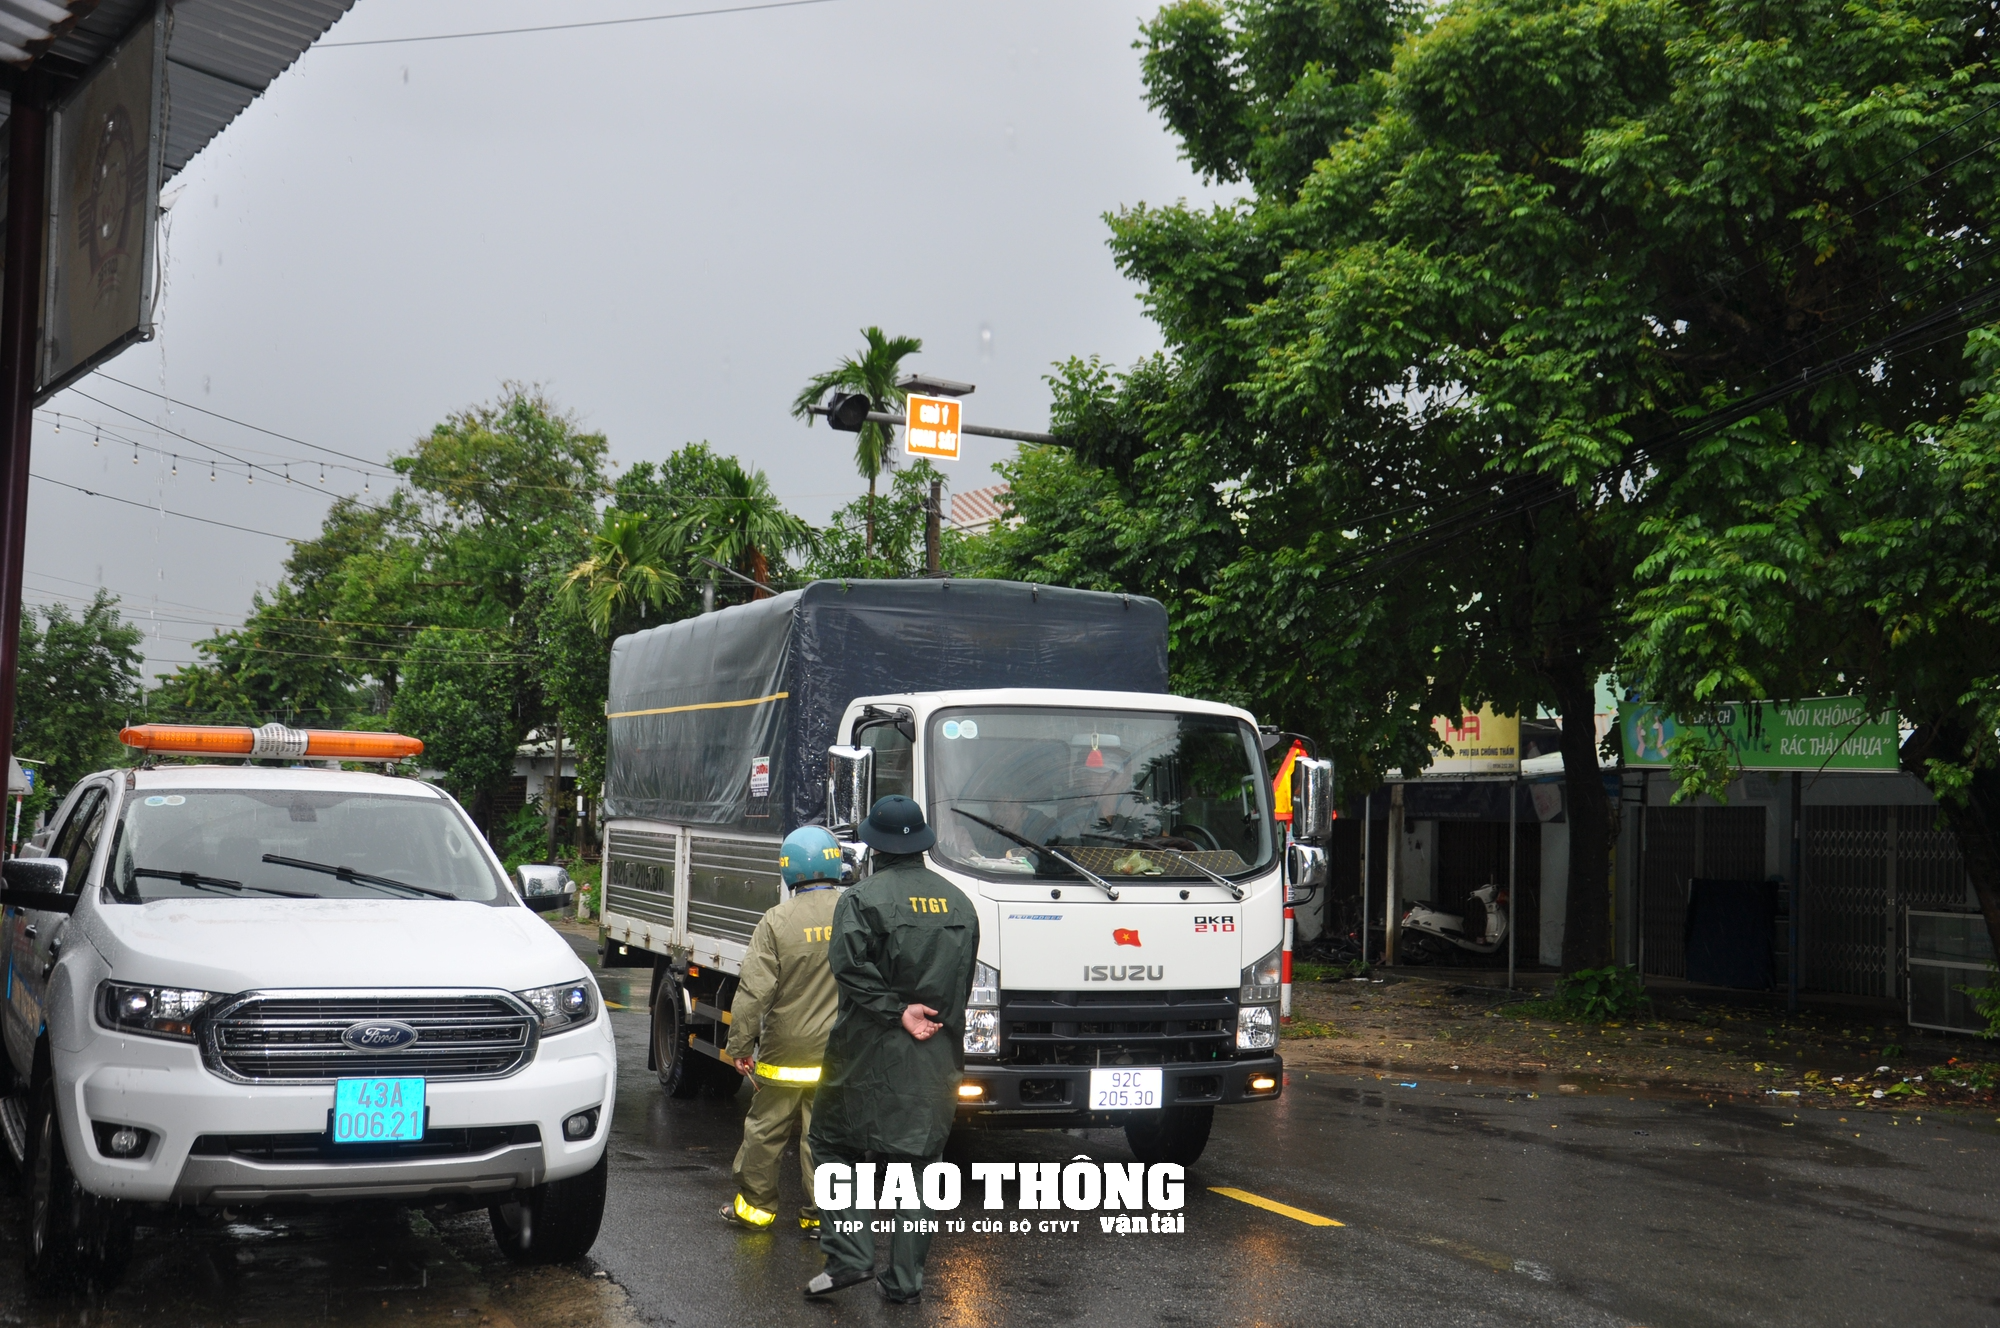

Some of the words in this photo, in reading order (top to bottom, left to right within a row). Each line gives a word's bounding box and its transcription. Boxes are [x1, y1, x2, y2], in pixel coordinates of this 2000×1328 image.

[937, 429, 957, 451] SÁT
[1812, 704, 1862, 727] KHÔNG
[1780, 733, 1807, 755] RÁC
[1809, 732, 1839, 756] THẢI
[909, 896, 949, 913] TTGT
[1194, 916, 1234, 924] QKR
[1195, 924, 1235, 932] 210
[803, 926, 833, 943] TTG
[1083, 965, 1163, 981] ISUZU
[361, 1027, 400, 1045] Ford
[1112, 1072, 1142, 1087] 92C
[357, 1082, 403, 1108] 43A
[1099, 1091, 1154, 1106] 205.30
[337, 1111, 418, 1138] 006.21
